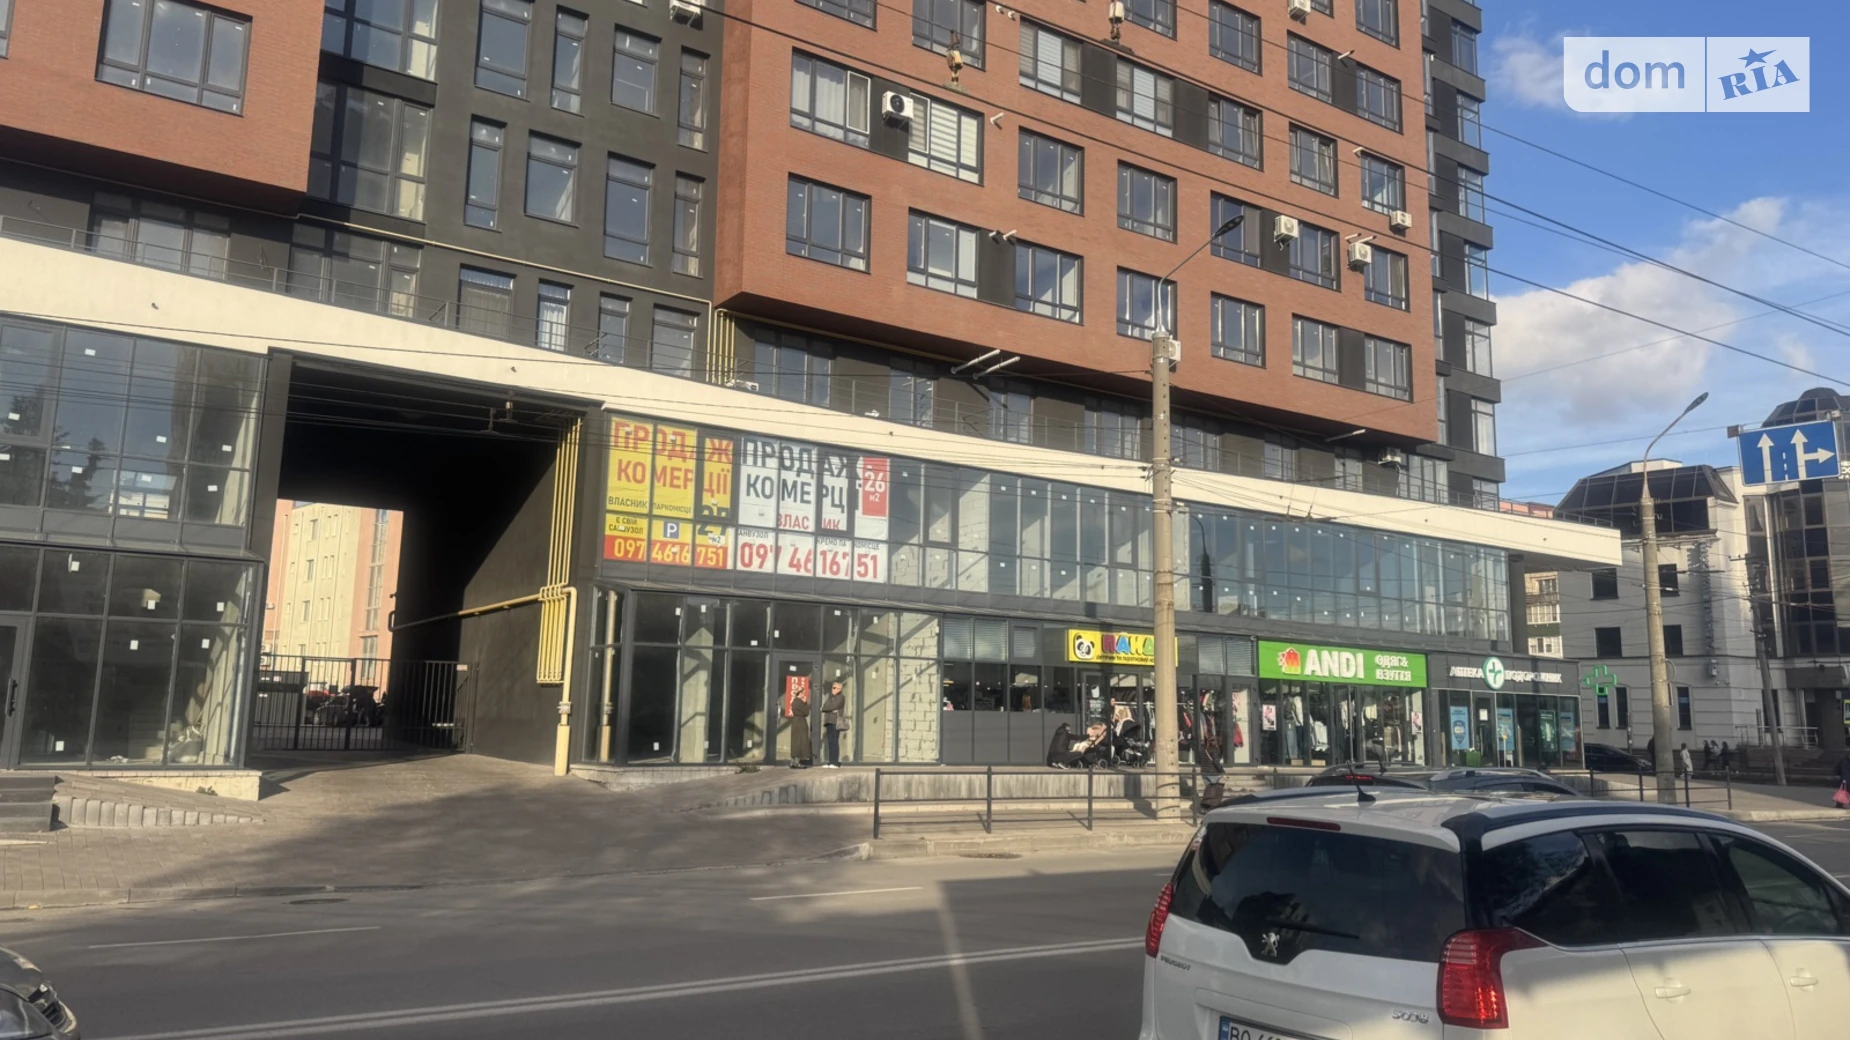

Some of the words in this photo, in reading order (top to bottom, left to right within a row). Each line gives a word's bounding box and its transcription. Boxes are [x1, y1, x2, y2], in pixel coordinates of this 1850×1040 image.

[613, 420, 733, 464] ПРОДЖ
[864, 471, 886, 493] 26
[608, 496, 648, 509] ВЛАСНИК
[778, 513, 840, 530] ВЛАСИК
[614, 538, 645, 559] 097
[697, 546, 724, 567] 751
[1101, 634, 1155, 656] ПАНД
[1304, 649, 1364, 679] ANDI
[1450, 666, 1484, 679] АПТЕКА
[1160, 955, 1191, 970] PEUGEOT
